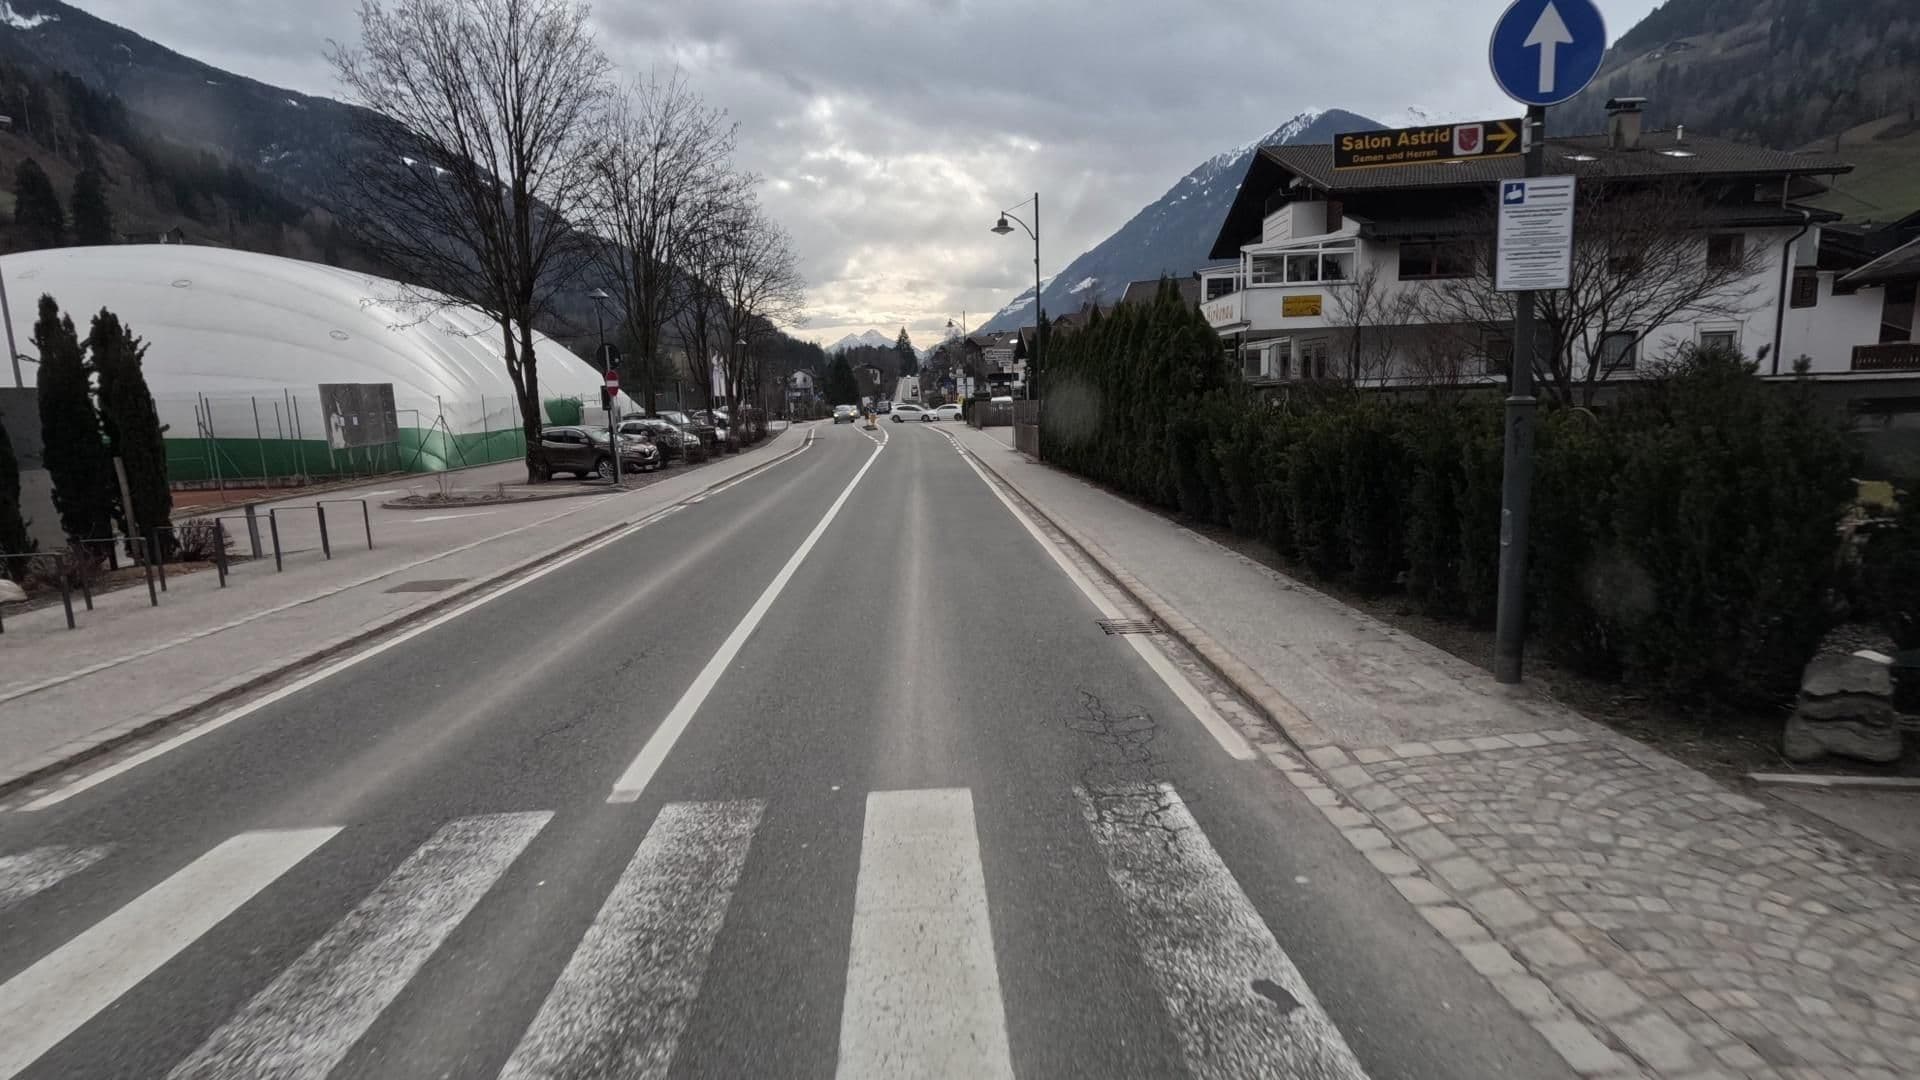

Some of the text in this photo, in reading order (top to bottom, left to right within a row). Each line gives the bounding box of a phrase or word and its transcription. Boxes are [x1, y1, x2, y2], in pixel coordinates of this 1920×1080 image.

[1342, 128, 1450, 151] Salon Astrid
[1352, 149, 1438, 163] Damen und Herren
